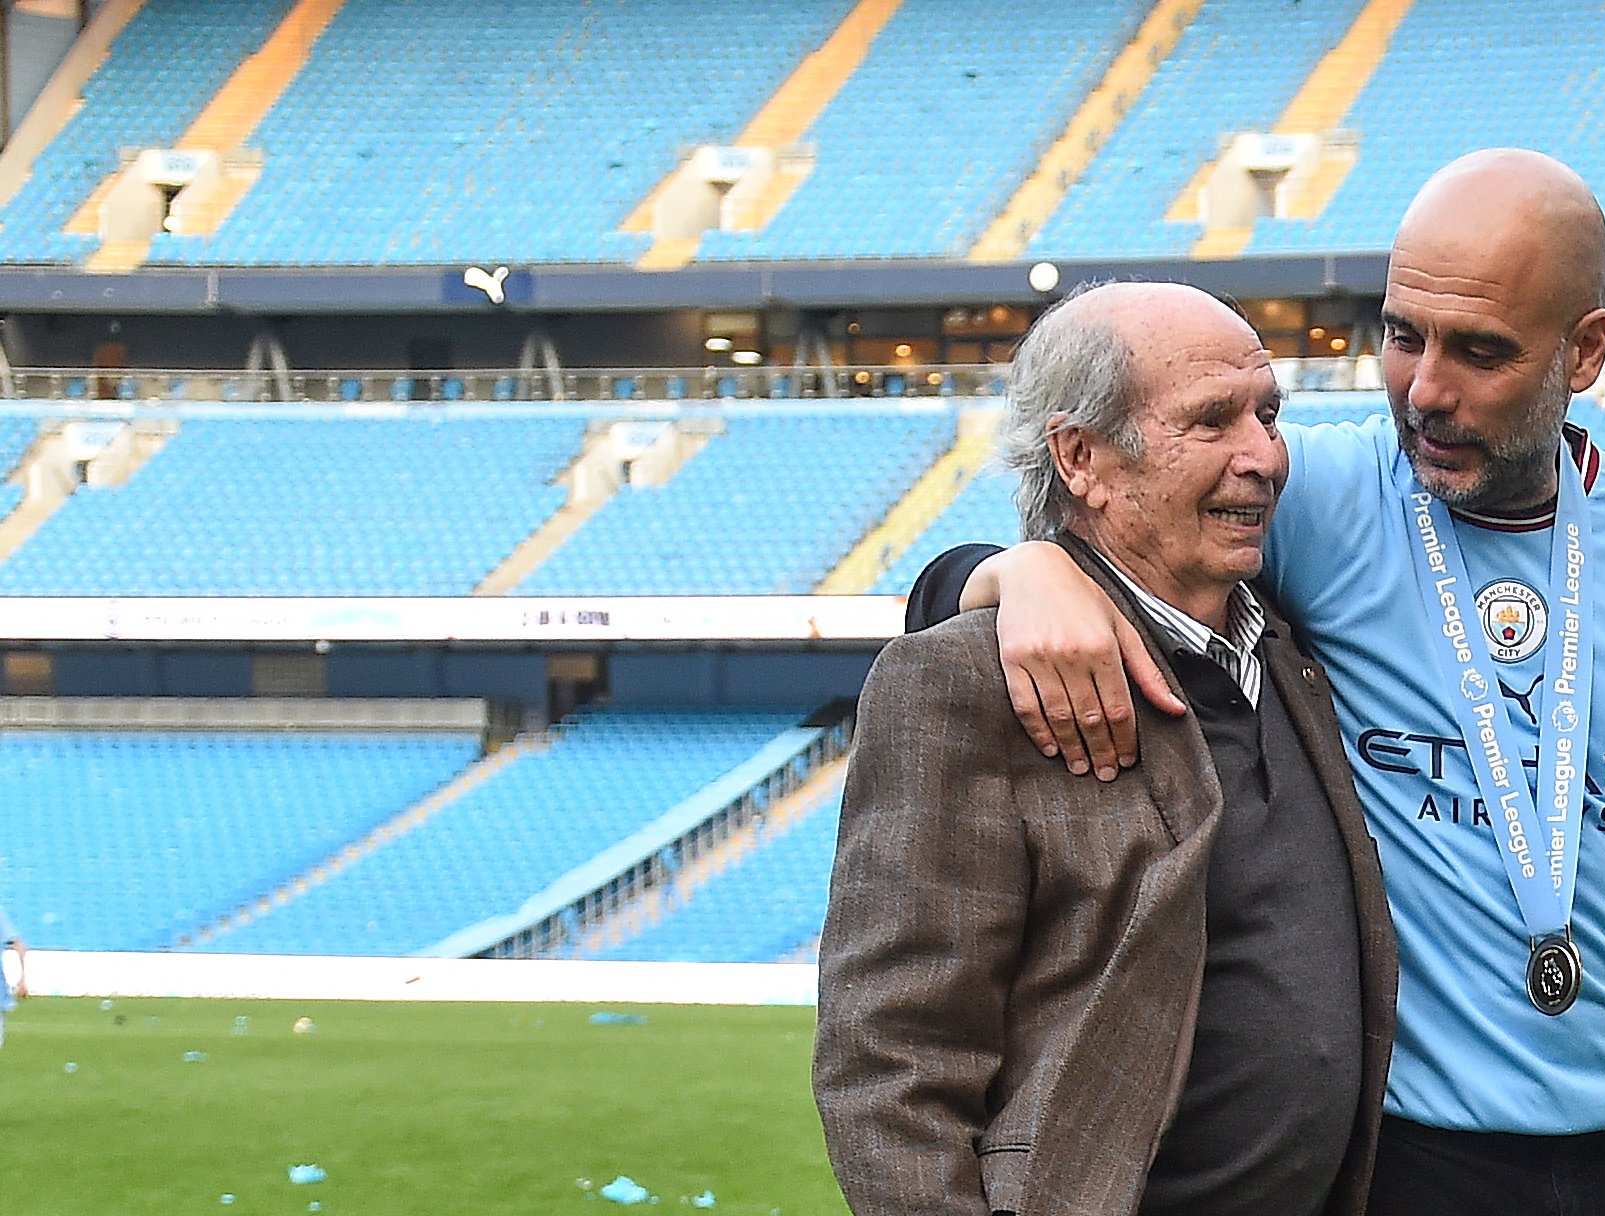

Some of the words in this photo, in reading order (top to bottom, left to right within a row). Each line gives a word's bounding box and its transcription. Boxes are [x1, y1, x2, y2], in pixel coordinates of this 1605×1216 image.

[1411, 491, 1448, 574] Premier
[1435, 577, 1473, 664] League
[1477, 586, 1541, 612] MANCHESTER
[1559, 522, 1585, 606] League
[1497, 648, 1521, 657] CITY
[1554, 609, 1580, 696] Premier
[1472, 702, 1510, 789] Premier
[1499, 790, 1536, 880] League
[1546, 737, 1576, 824] League
[1545, 827, 1567, 898] emier
